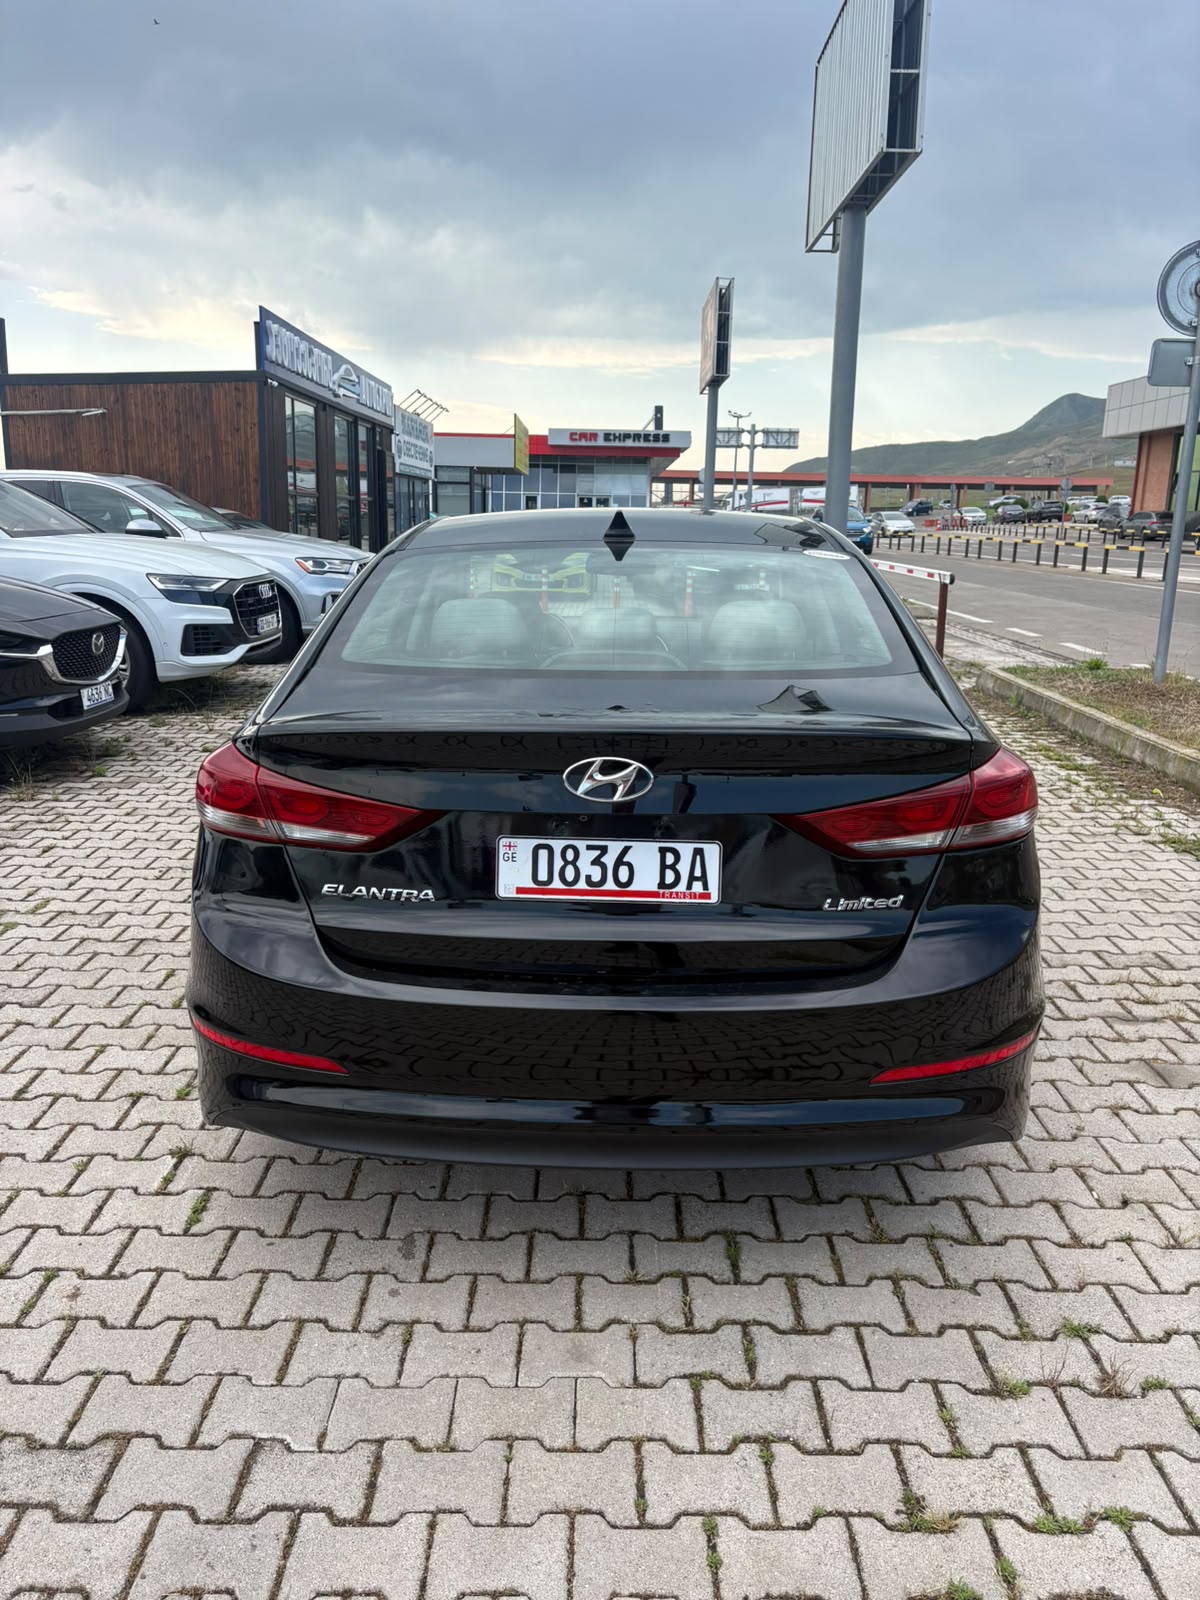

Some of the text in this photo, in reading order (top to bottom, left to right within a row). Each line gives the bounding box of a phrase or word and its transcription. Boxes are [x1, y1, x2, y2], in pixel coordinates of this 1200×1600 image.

[569, 432, 671, 443] CAR EXPRESS
[502, 852, 517, 862] GE
[531, 843, 709, 891] 0836 BA
[321, 883, 436, 902] ELANTRA
[659, 891, 699, 899] TRANSIT
[822, 894, 904, 911] Limited
